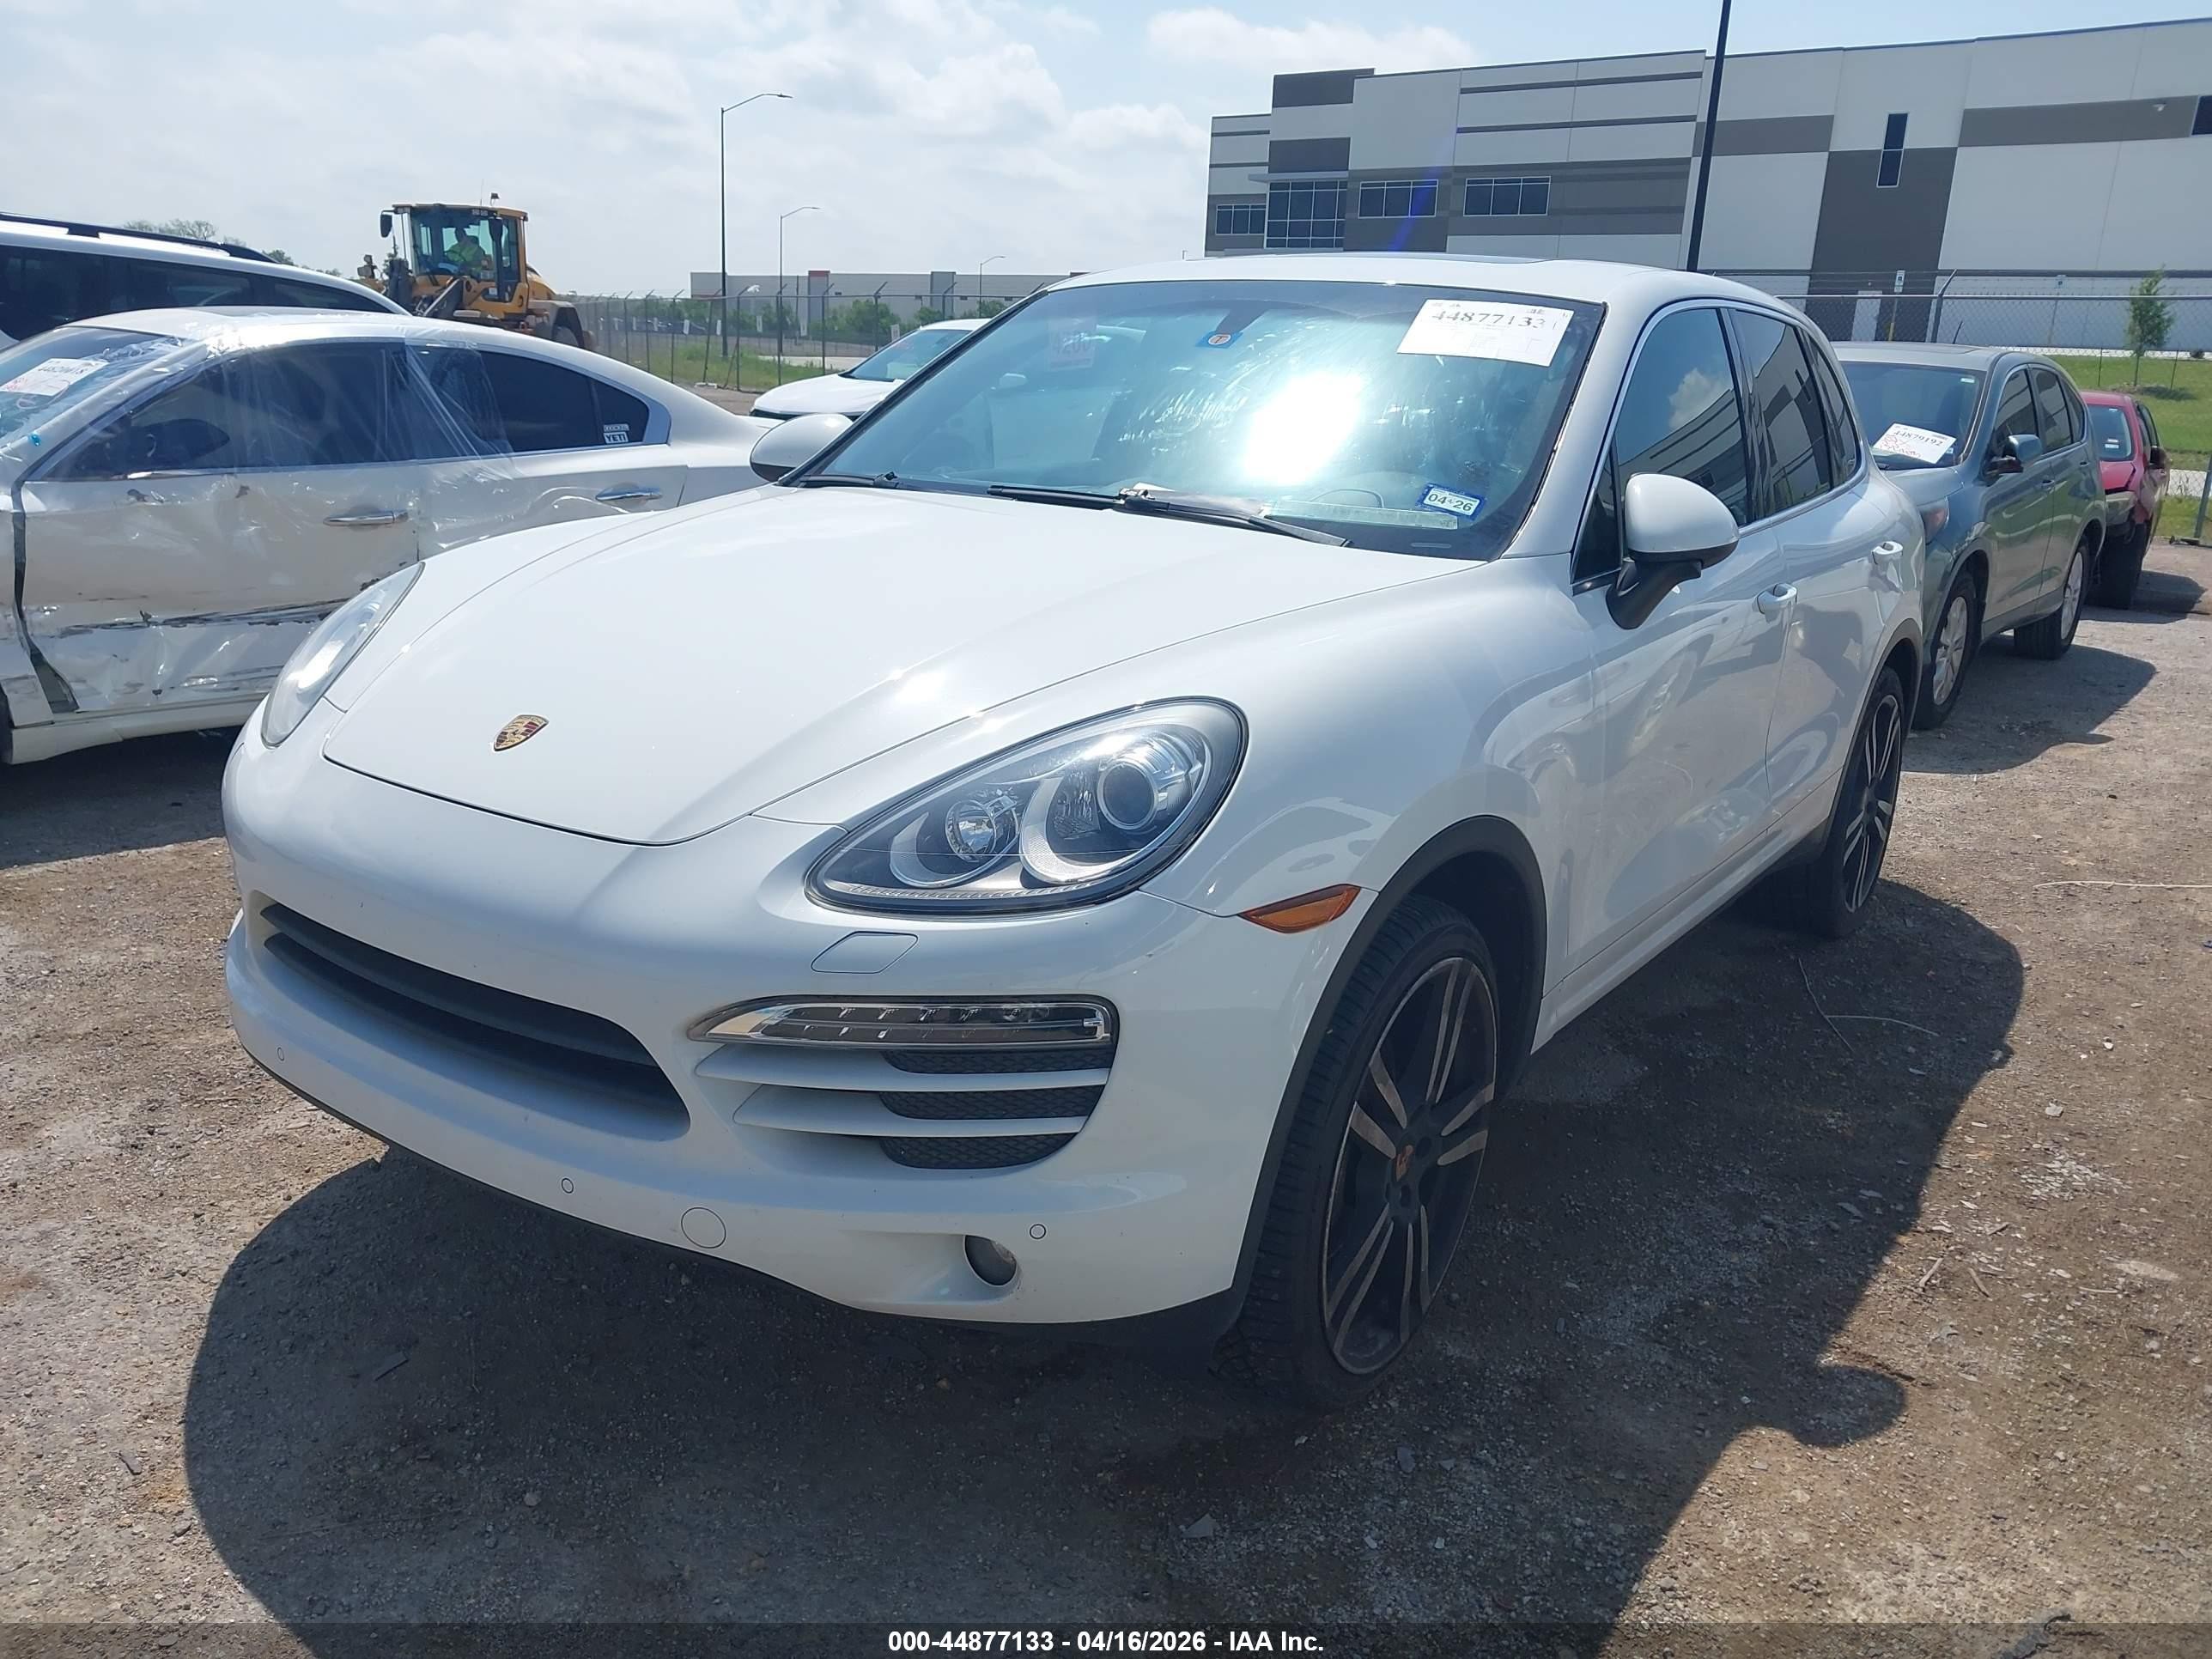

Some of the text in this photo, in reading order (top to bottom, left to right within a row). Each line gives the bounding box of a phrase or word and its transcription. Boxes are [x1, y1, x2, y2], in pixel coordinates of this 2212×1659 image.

[1432, 310, 1546, 329] 44877133
[605, 434, 626, 442] YETI
[1428, 493, 1447, 504] 04
[1453, 500, 1474, 512] 26
